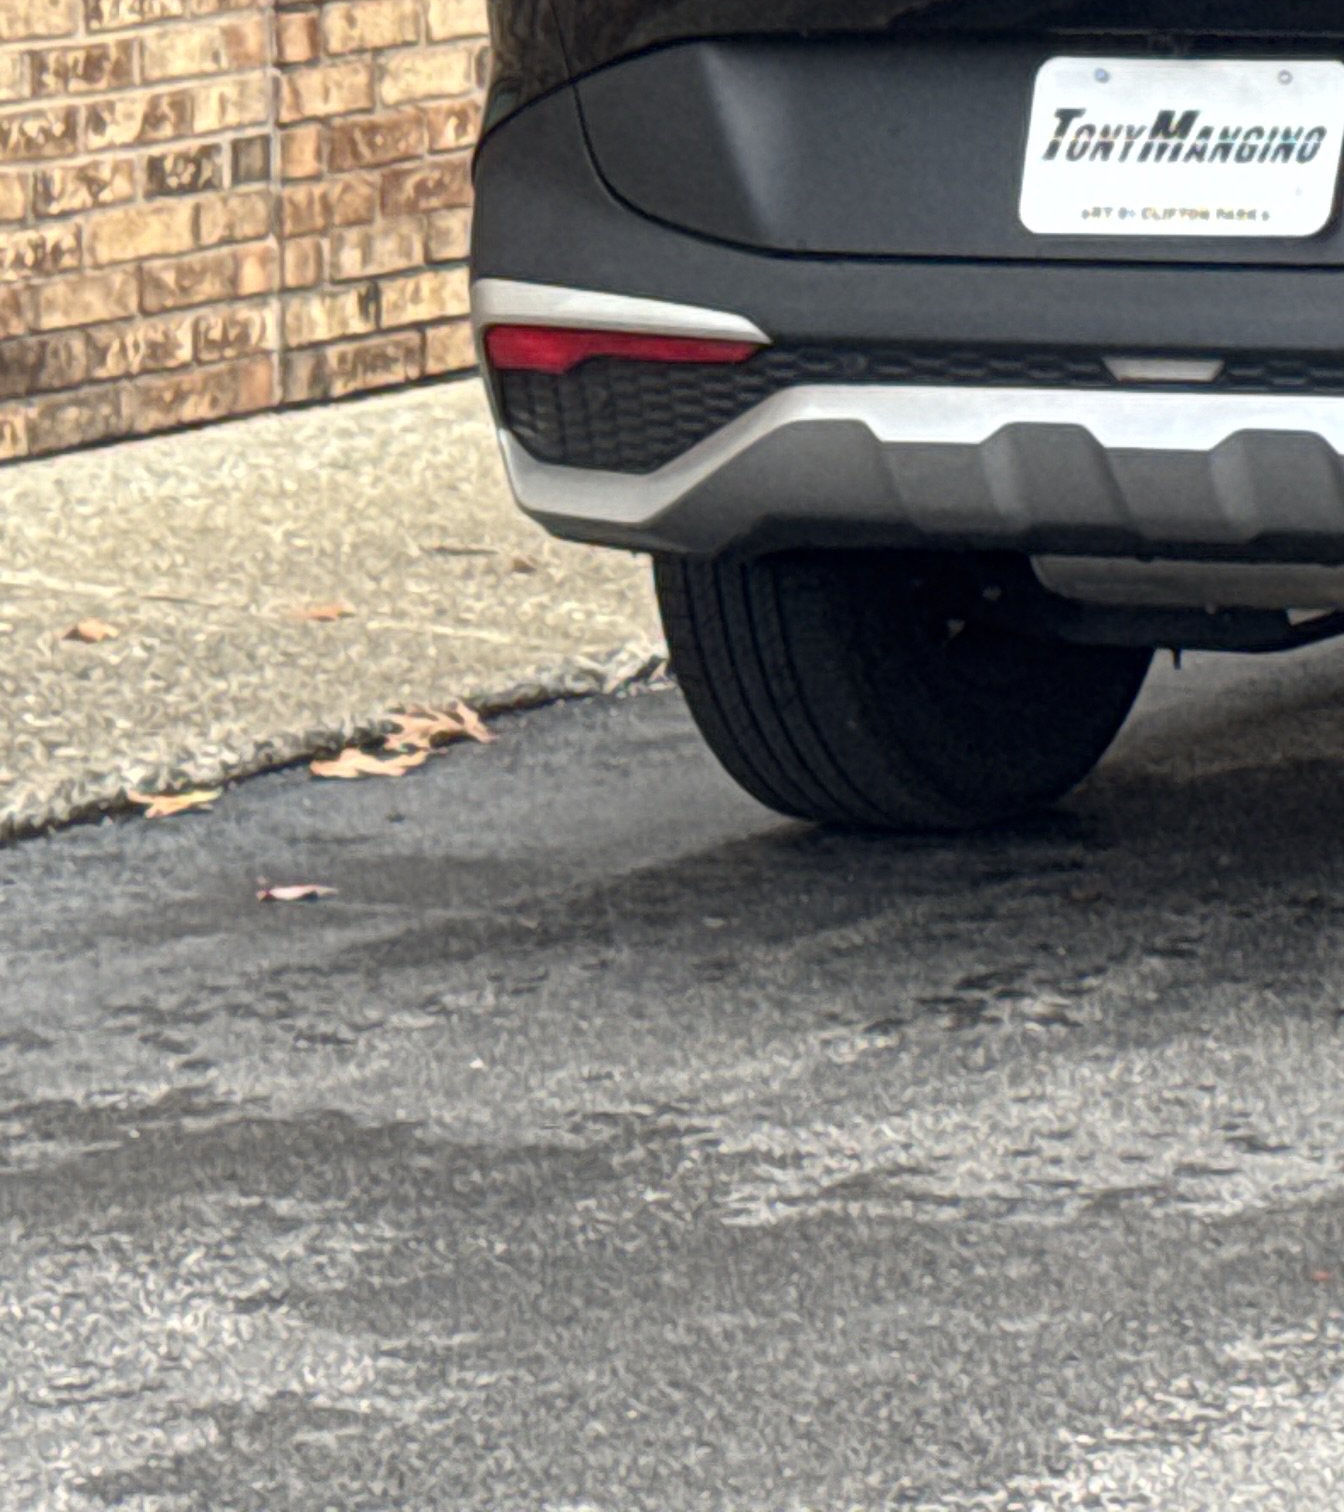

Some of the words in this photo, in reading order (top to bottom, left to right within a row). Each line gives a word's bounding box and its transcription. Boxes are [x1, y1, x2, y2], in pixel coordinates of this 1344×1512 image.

[1041, 107, 1148, 163] TONY
[1137, 109, 1328, 164] MANGINO
[1141, 206, 1210, 220] CLIFTON
